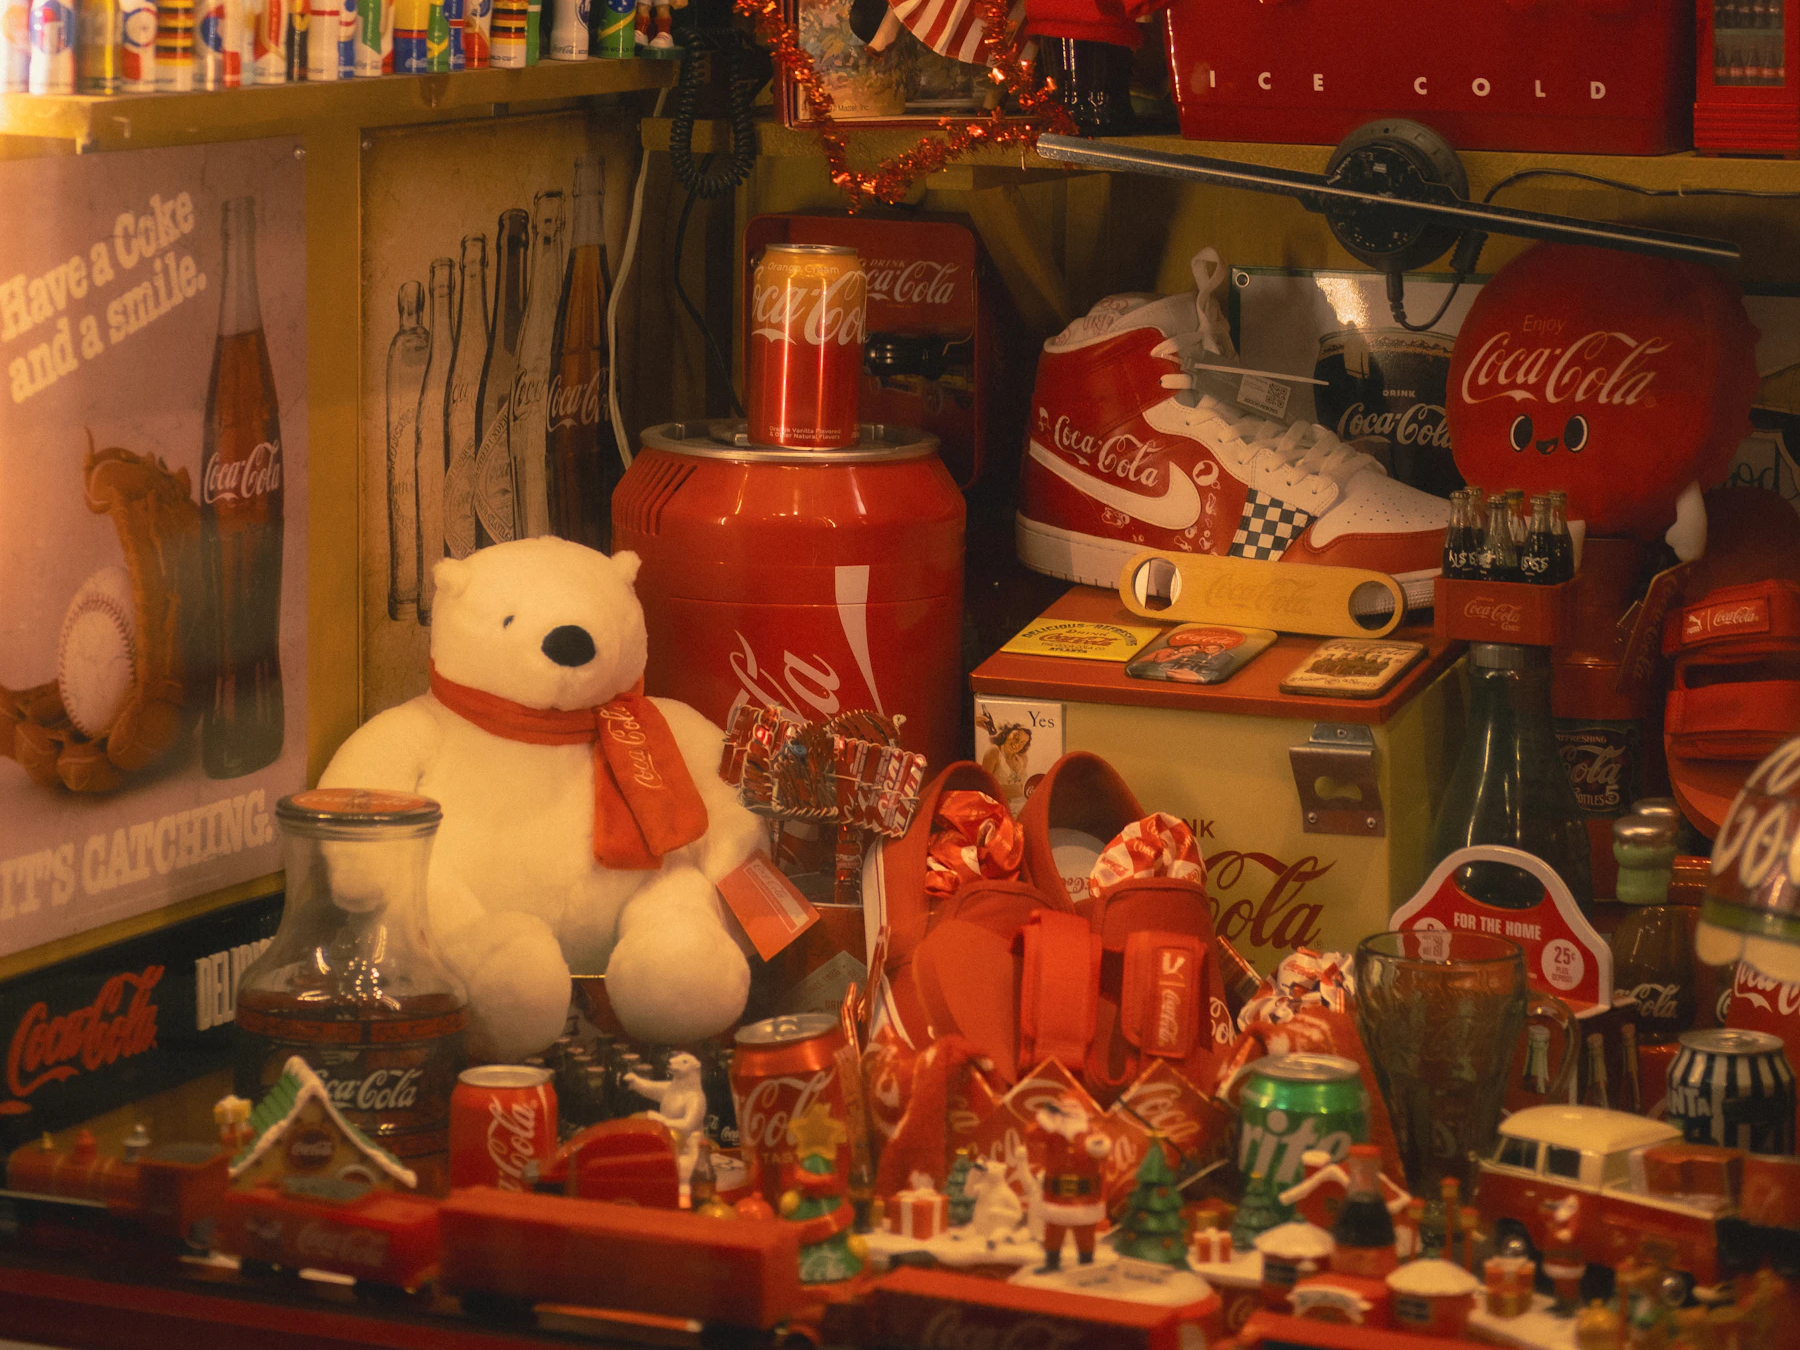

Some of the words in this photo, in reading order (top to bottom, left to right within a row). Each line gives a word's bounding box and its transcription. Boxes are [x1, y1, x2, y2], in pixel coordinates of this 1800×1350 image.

[0, 252, 89, 340] Have
[90, 241, 114, 287] a
[113, 191, 196, 271] Coke
[803, 263, 840, 275] Cream
[869, 258, 906, 268] DRINK
[8, 317, 80, 405] and
[80, 313, 105, 360] a
[105, 251, 207, 346] smile.
[1522, 314, 1568, 335] Enjoy
[1461, 330, 1674, 407] Coca-Cola
[1382, 389, 1416, 399] DRINK
[1054, 415, 1164, 488] Coca-Cola
[204, 439, 281, 504] Coca-Cola
[1713, 606, 1758, 627] Coca-Cola
[1027, 709, 1056, 730] Yes
[1453, 911, 1476, 931] FOR
[1479, 916, 1502, 935] THE
[1505, 920, 1542, 941] HOME
[8, 964, 166, 1096] Coca-Cola
